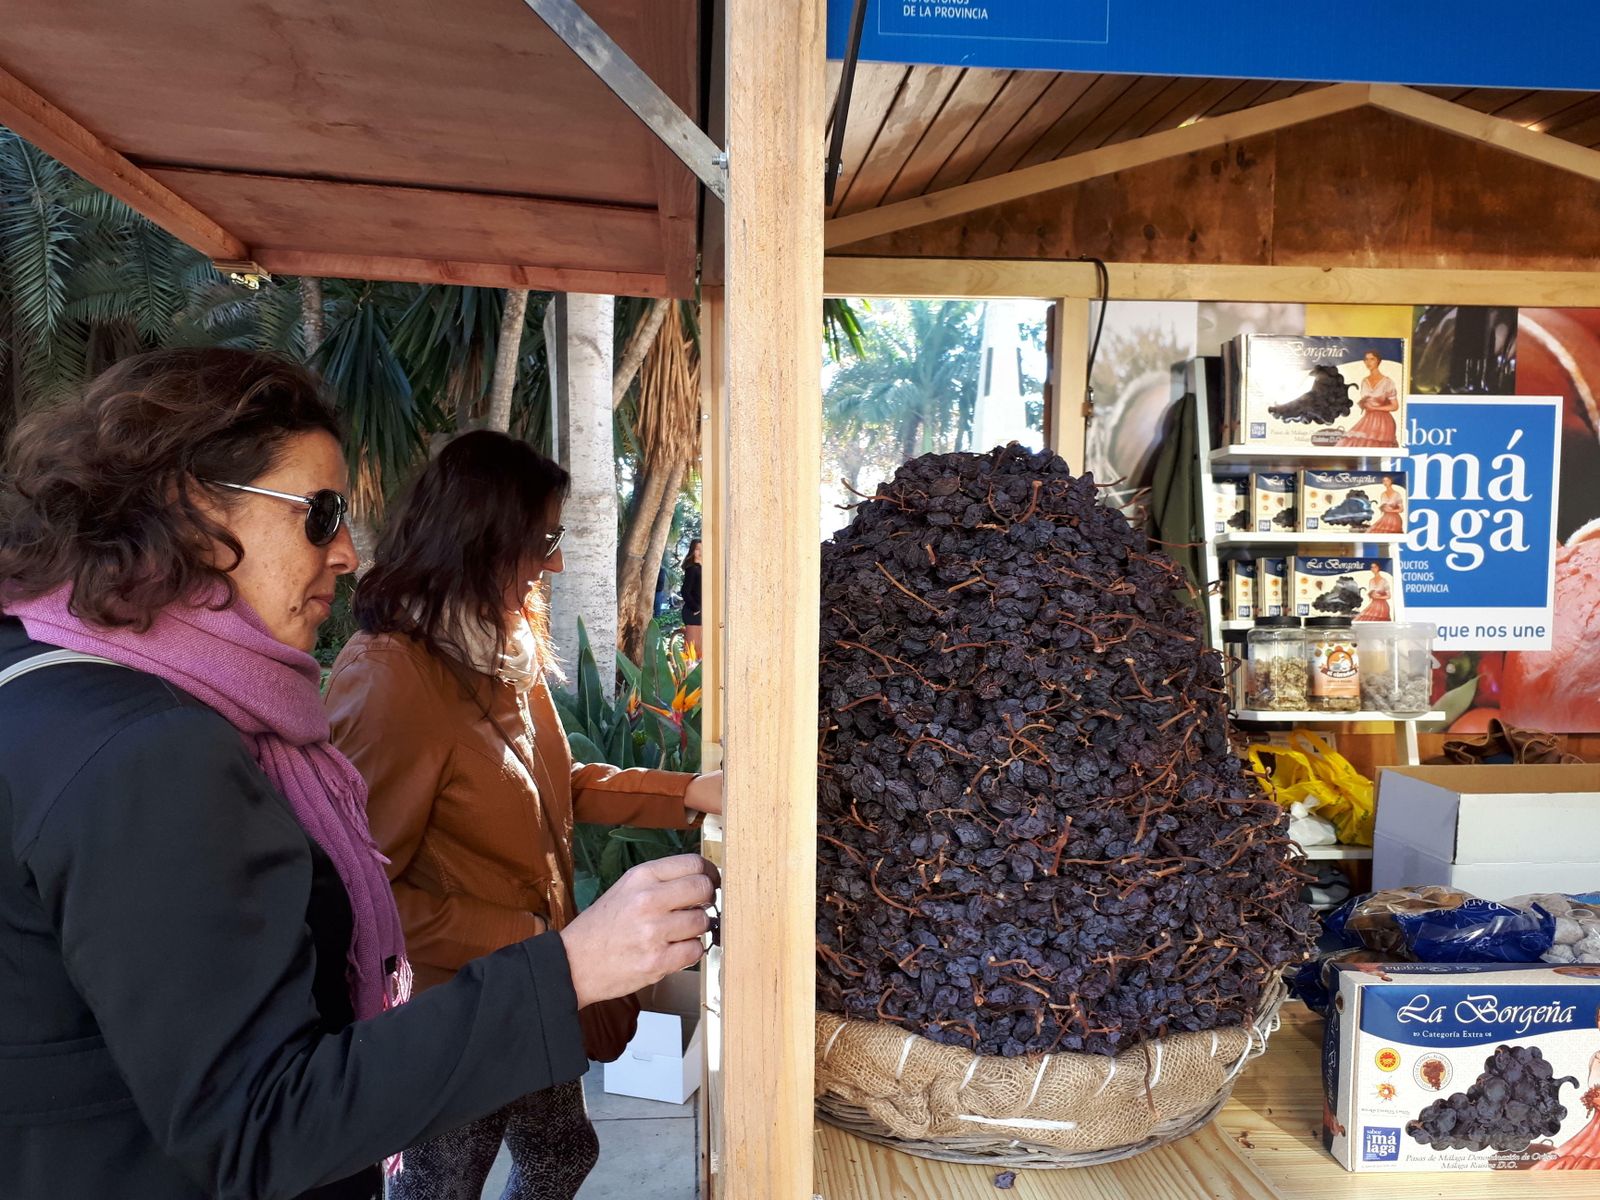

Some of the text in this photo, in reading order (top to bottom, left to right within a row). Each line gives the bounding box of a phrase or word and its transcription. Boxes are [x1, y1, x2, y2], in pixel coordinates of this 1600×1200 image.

[903, 5, 988, 19] DE LA PROVINCIA
[1408, 429, 1533, 502] má
[1402, 508, 1531, 571] aga
[1405, 583, 1449, 593] PROVINCIA
[1437, 625, 1546, 641] que nos une
[1396, 994, 1577, 1034] La Borgeña
[1422, 1030, 1484, 1039] Categoría Extra
[1366, 1140, 1397, 1157] laga
